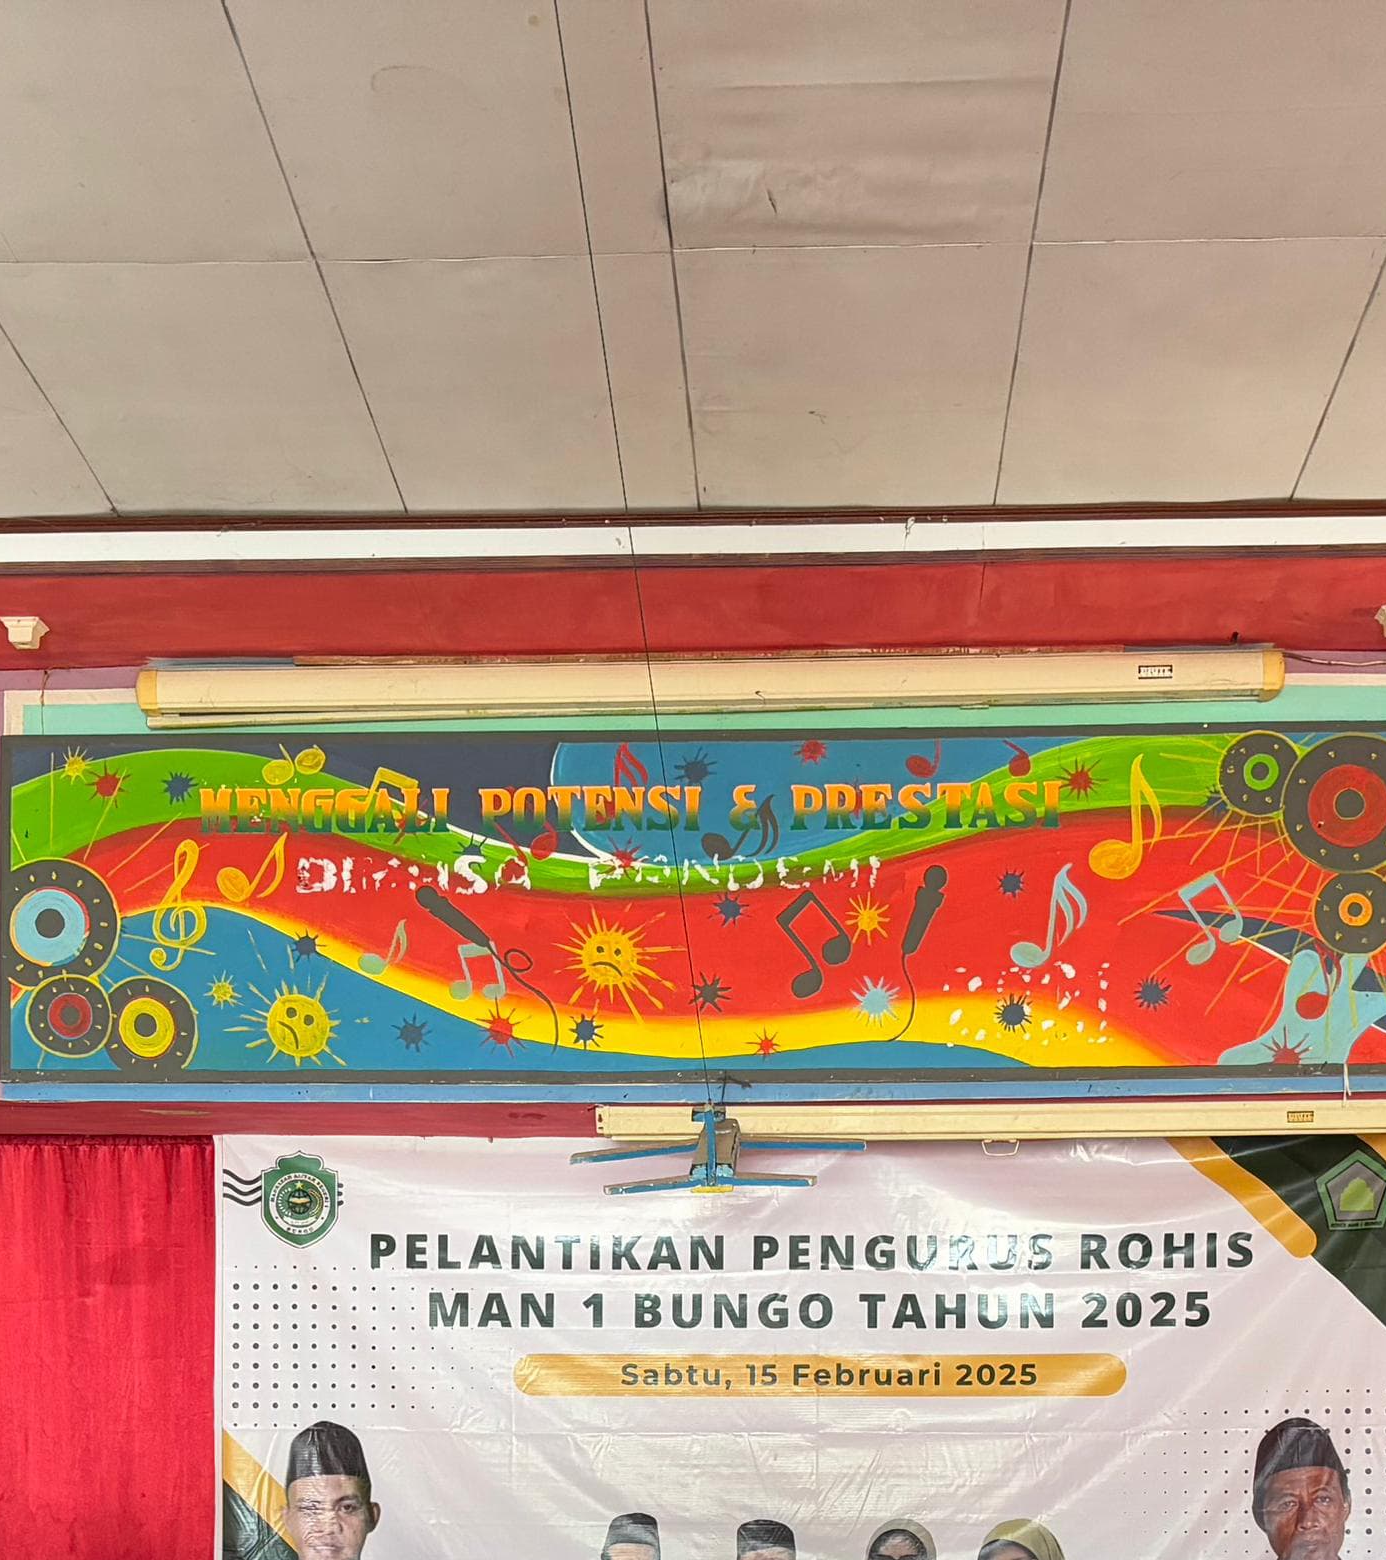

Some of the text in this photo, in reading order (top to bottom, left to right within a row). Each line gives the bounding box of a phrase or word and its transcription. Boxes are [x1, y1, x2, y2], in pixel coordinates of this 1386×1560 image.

[200, 780, 1063, 833] MENGGALI POTENSI & PRESTASI
[370, 1231, 1254, 1271] PELANTIKAN PENGURUS ROHIS
[428, 1290, 1211, 1329] MAN 1 BUNGO TAHUN 2025
[621, 1361, 1038, 1391] Sabtu, 15 Februari 2025
